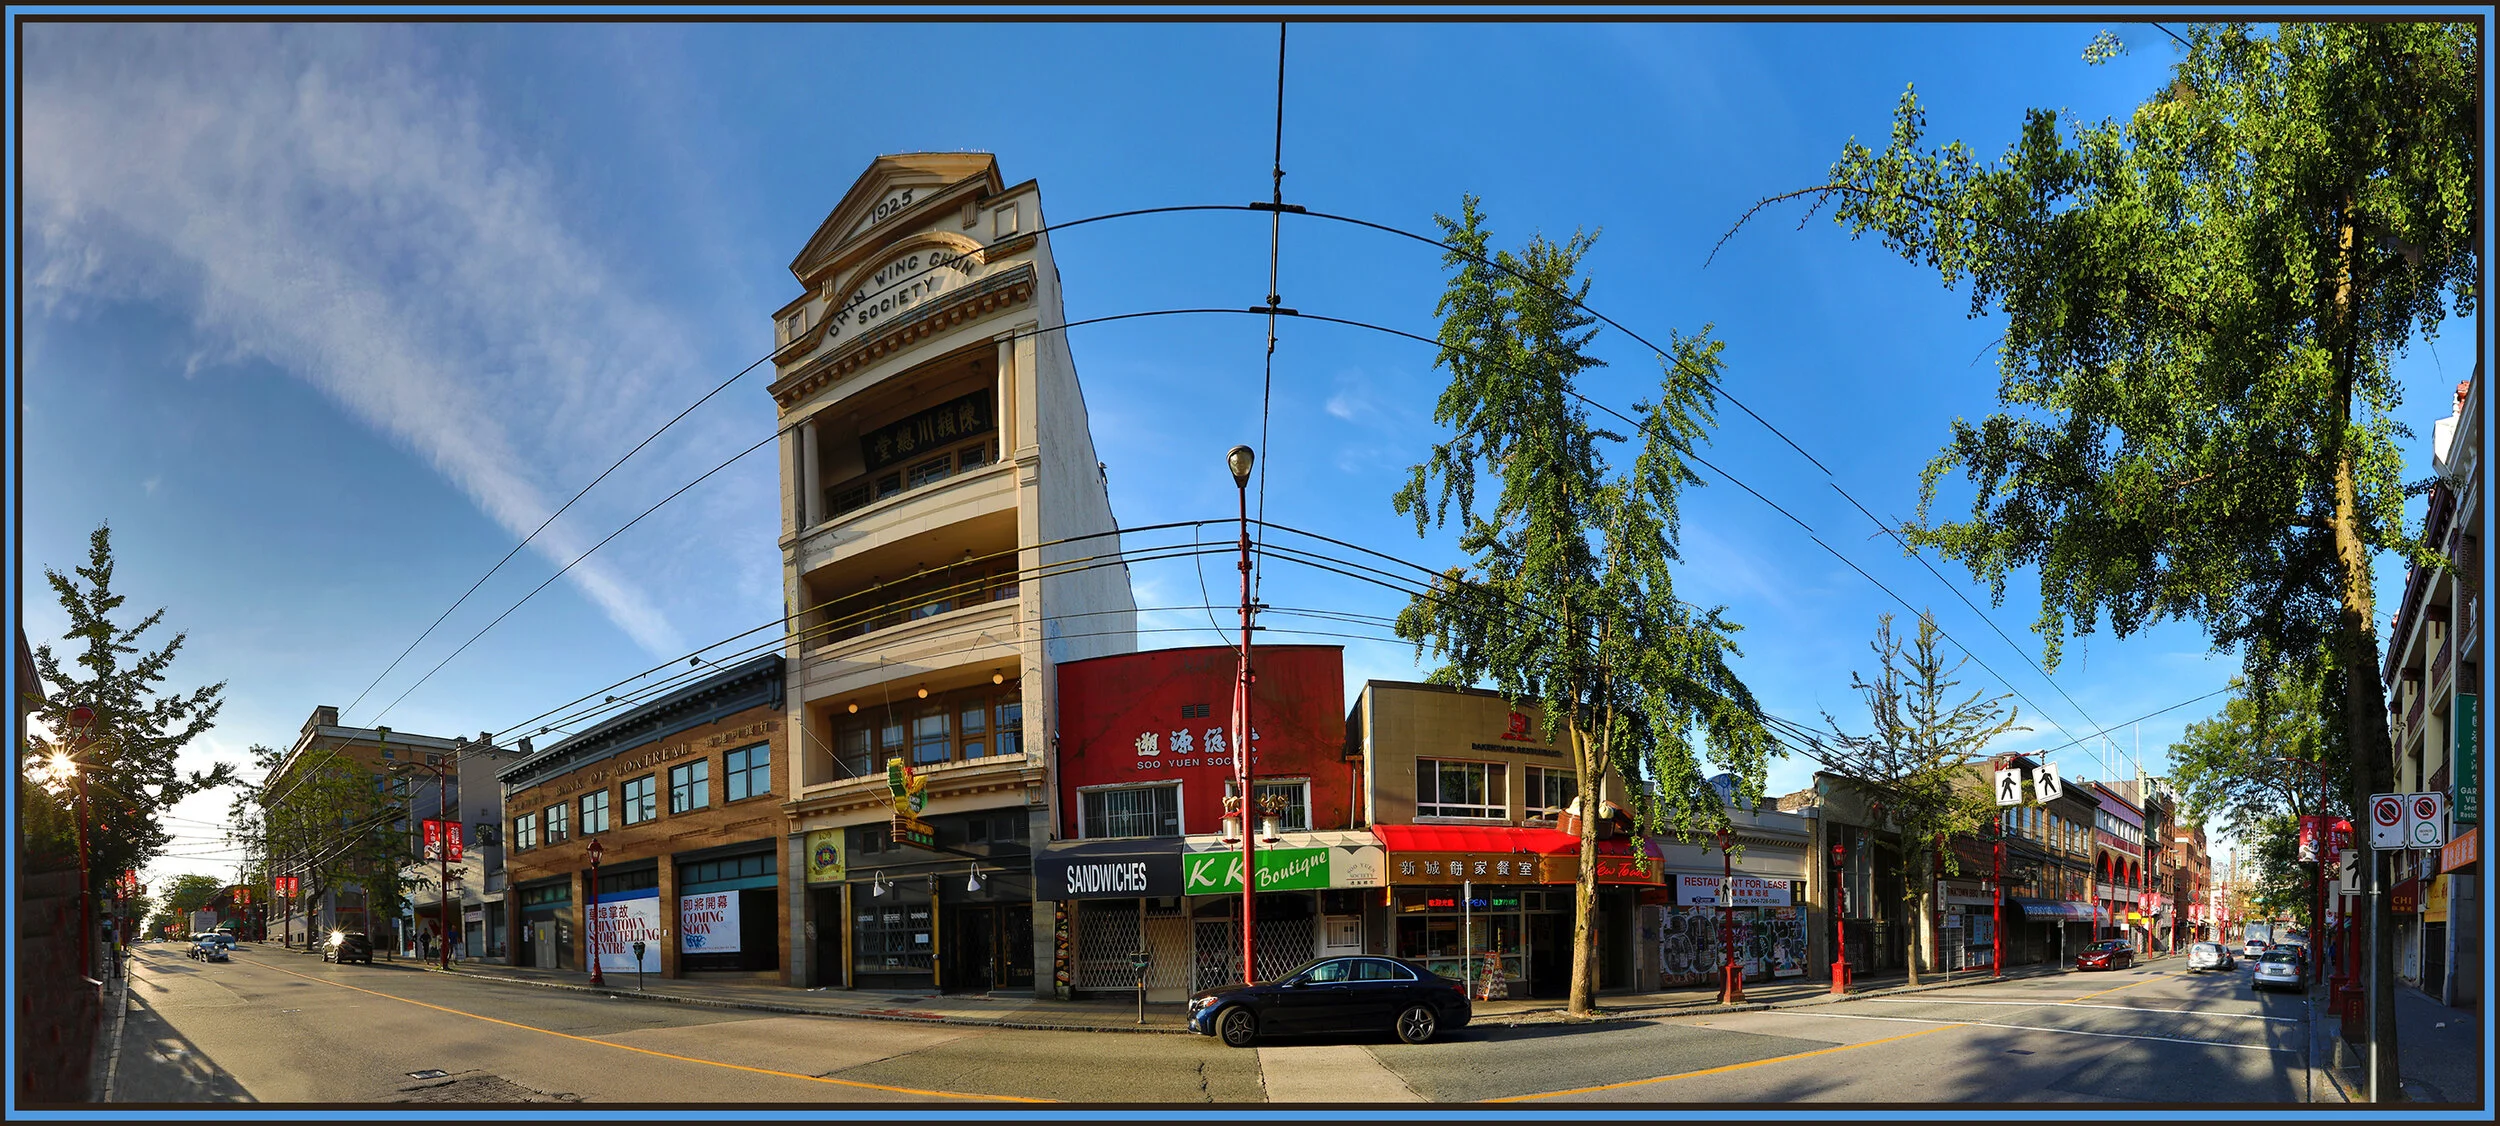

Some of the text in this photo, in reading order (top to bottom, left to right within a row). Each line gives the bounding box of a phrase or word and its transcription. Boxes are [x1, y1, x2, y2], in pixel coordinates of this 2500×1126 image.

[872, 188, 914, 224] 1925
[829, 252, 975, 338] CHIN WING CHUN
[858, 276, 934, 325] SOCIETY
[555, 743, 689, 797] BANK OF MONTREAL
[1137, 760, 1161, 770] SOO
[1168, 758, 1200, 767] YUEN
[1188, 851, 1328, 889] K K Boutique
[1400, 860, 1534, 877] 新城餅家餐室
[1596, 859, 1616, 877] ew
[1067, 862, 1147, 894] SANDWICHES
[1684, 876, 1787, 890] RESTAUNT FOR LEASE
[683, 895, 728, 912] 即將開幕
[2392, 896, 2412, 905] CHI
[588, 917, 646, 933] CHINATOWN
[683, 911, 724, 925] COMING
[683, 923, 711, 935] SOON
